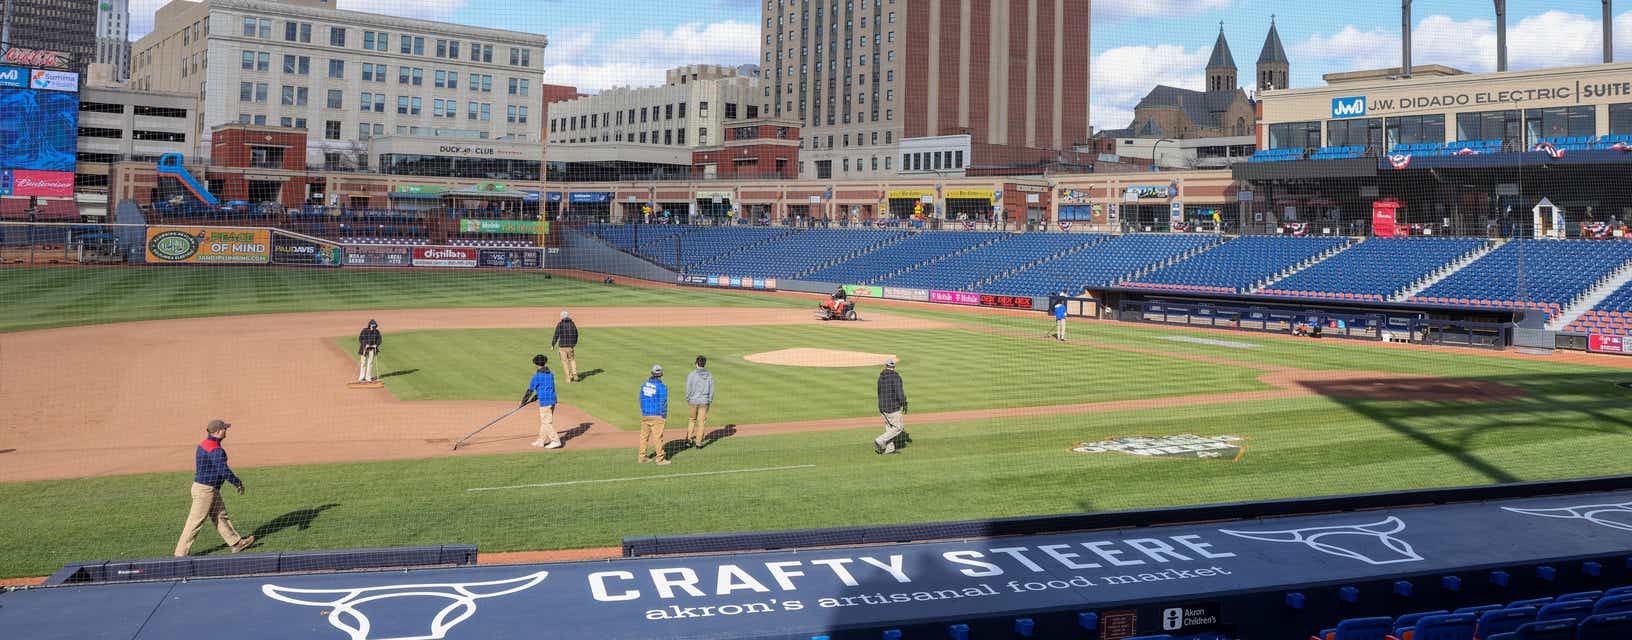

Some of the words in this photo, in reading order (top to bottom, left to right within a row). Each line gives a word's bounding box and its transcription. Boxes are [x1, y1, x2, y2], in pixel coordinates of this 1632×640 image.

[1400, 94, 1469, 109] DIDADO
[1476, 86, 1570, 104] ELECTRIC
[440, 145, 461, 153] DUCK
[475, 147, 494, 155] CLUB
[210, 232, 255, 242] PEACE
[210, 243, 229, 253] OF
[232, 243, 266, 253] MIND
[587, 554, 912, 602] CRAFTY
[942, 534, 1237, 577] STEERE
[646, 598, 804, 620] akron's
[819, 583, 1001, 608] artisanal
[1008, 575, 1097, 593] food
[1103, 565, 1232, 585] market
[1184, 608, 1205, 617] Akron
[1184, 615, 1216, 626] Children's
